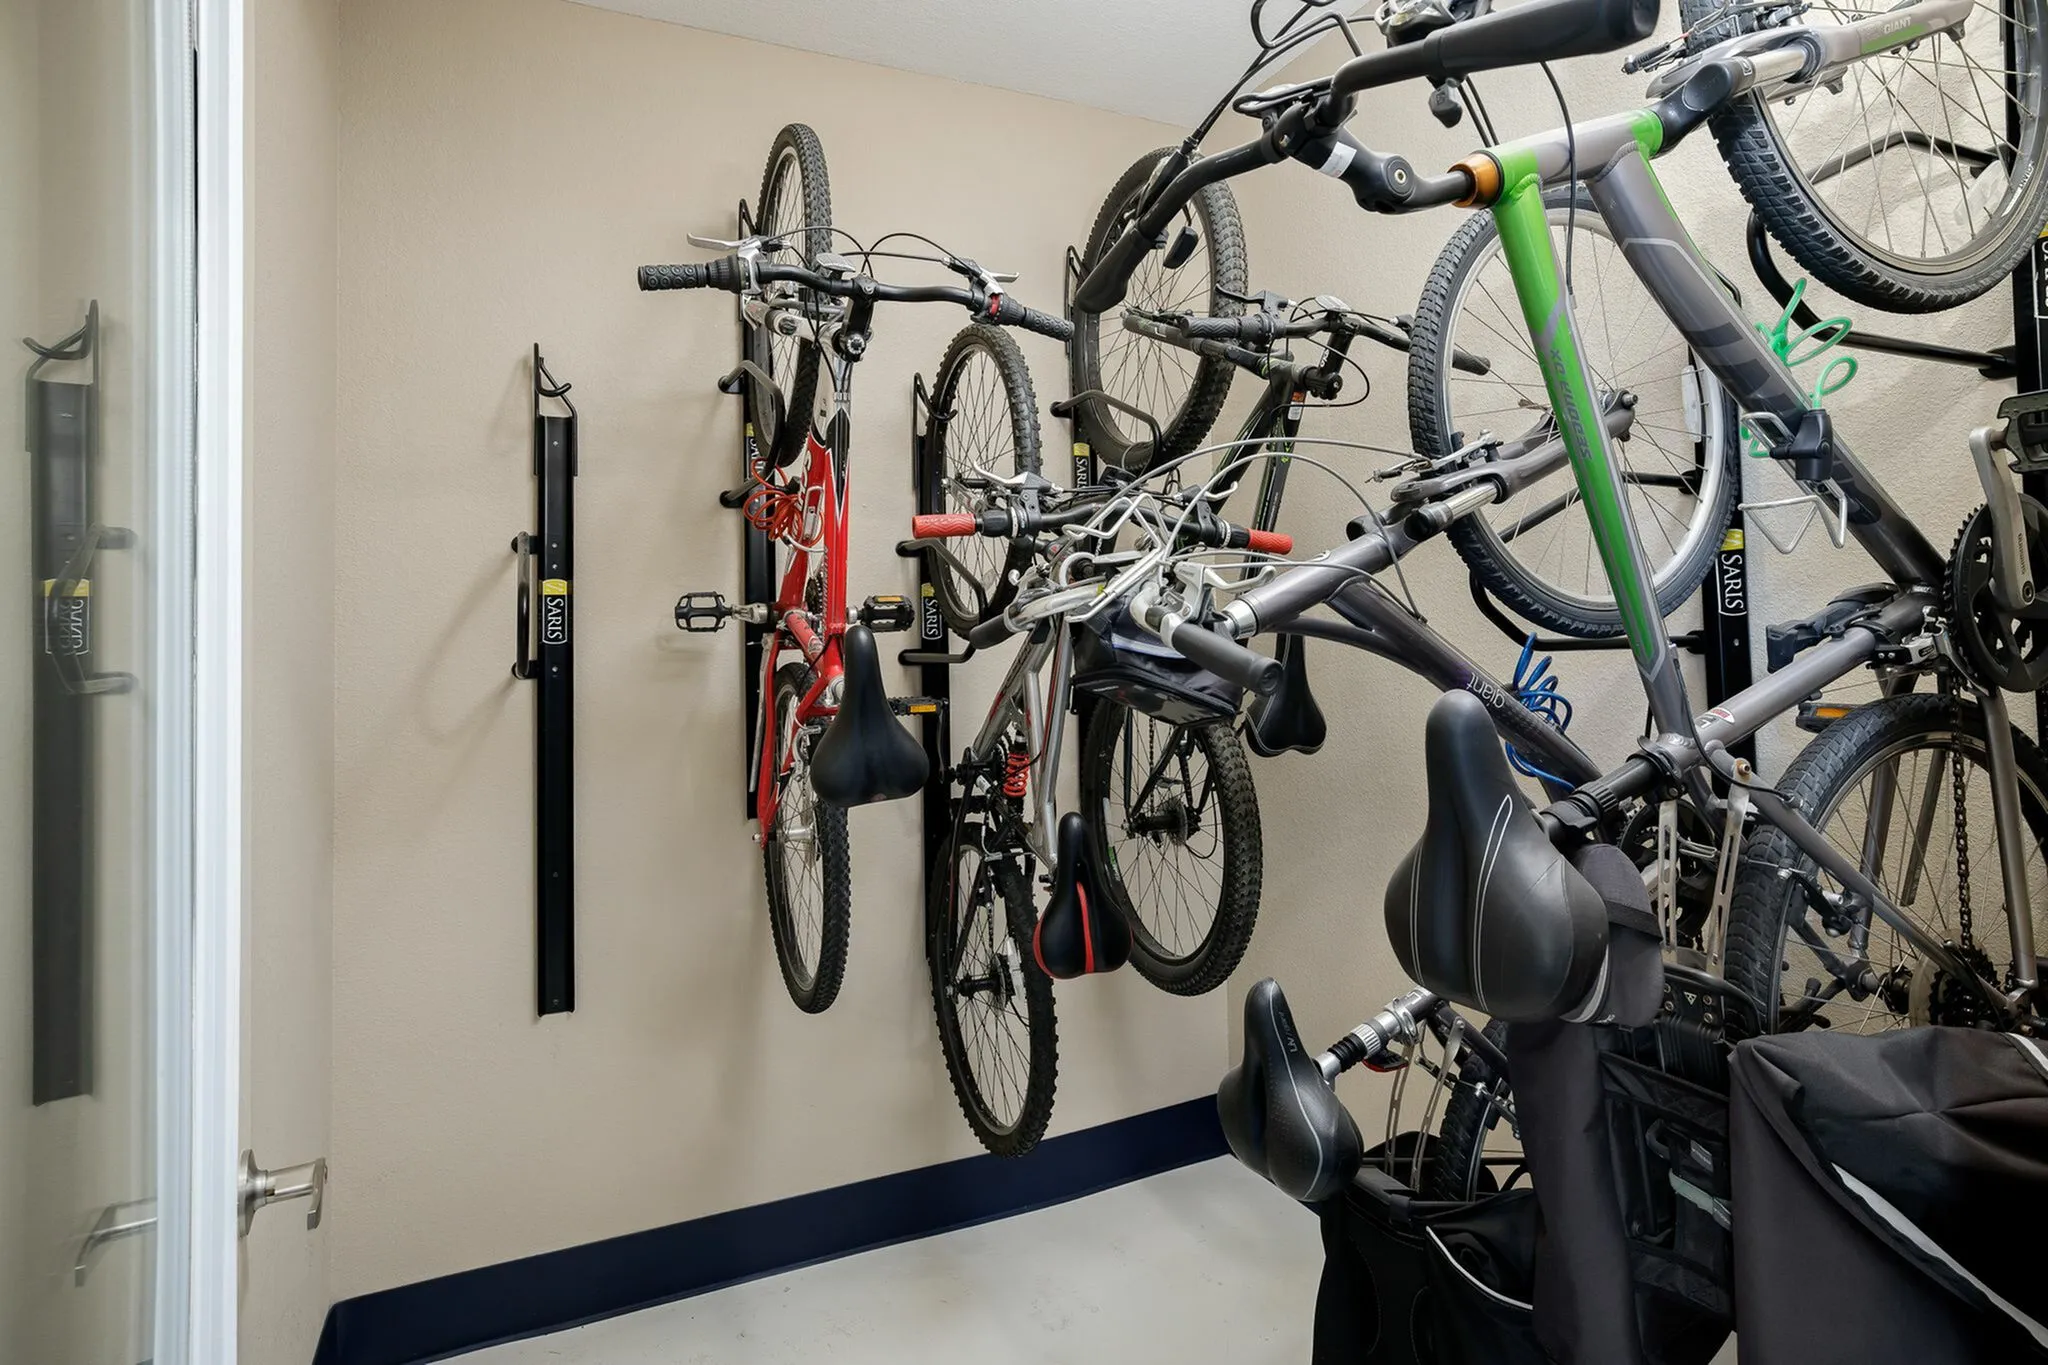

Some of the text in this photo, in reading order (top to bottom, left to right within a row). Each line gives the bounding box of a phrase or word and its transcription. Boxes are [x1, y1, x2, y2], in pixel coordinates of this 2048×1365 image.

[1883, 16, 1912, 35] GIANT
[1721, 553, 1745, 609] SARIS
[546, 596, 564, 640] SARIS
[925, 598, 938, 635] SARIS
[1465, 671, 1505, 709] giant
